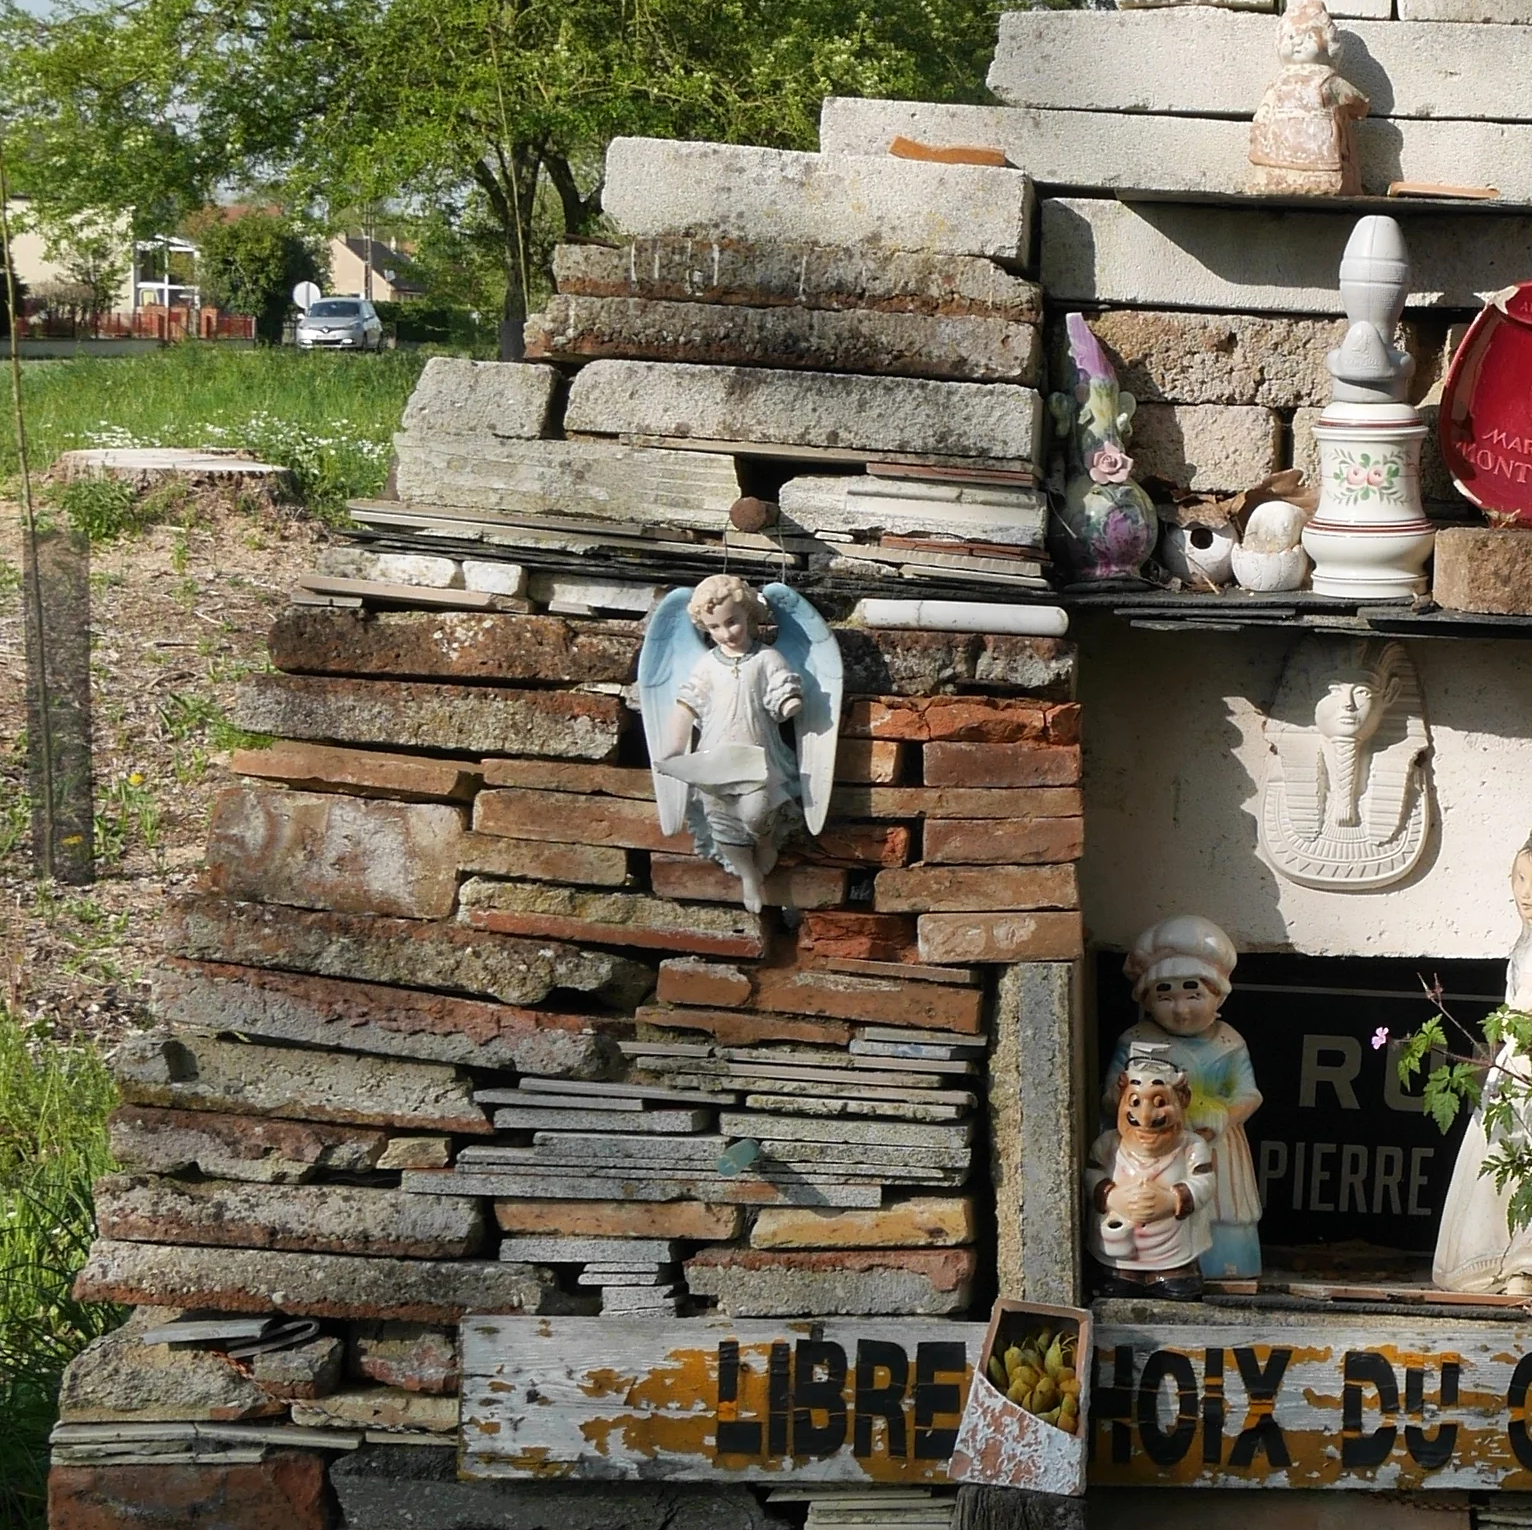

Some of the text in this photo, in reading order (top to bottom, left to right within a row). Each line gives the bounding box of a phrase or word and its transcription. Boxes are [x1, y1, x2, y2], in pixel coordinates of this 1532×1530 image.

[1258, 1140, 1435, 1216] PIERRE
[716, 1337, 966, 1460] LIBRE
[1089, 1344, 1294, 1468] HOIX
[1341, 1351, 1459, 1470] DU
